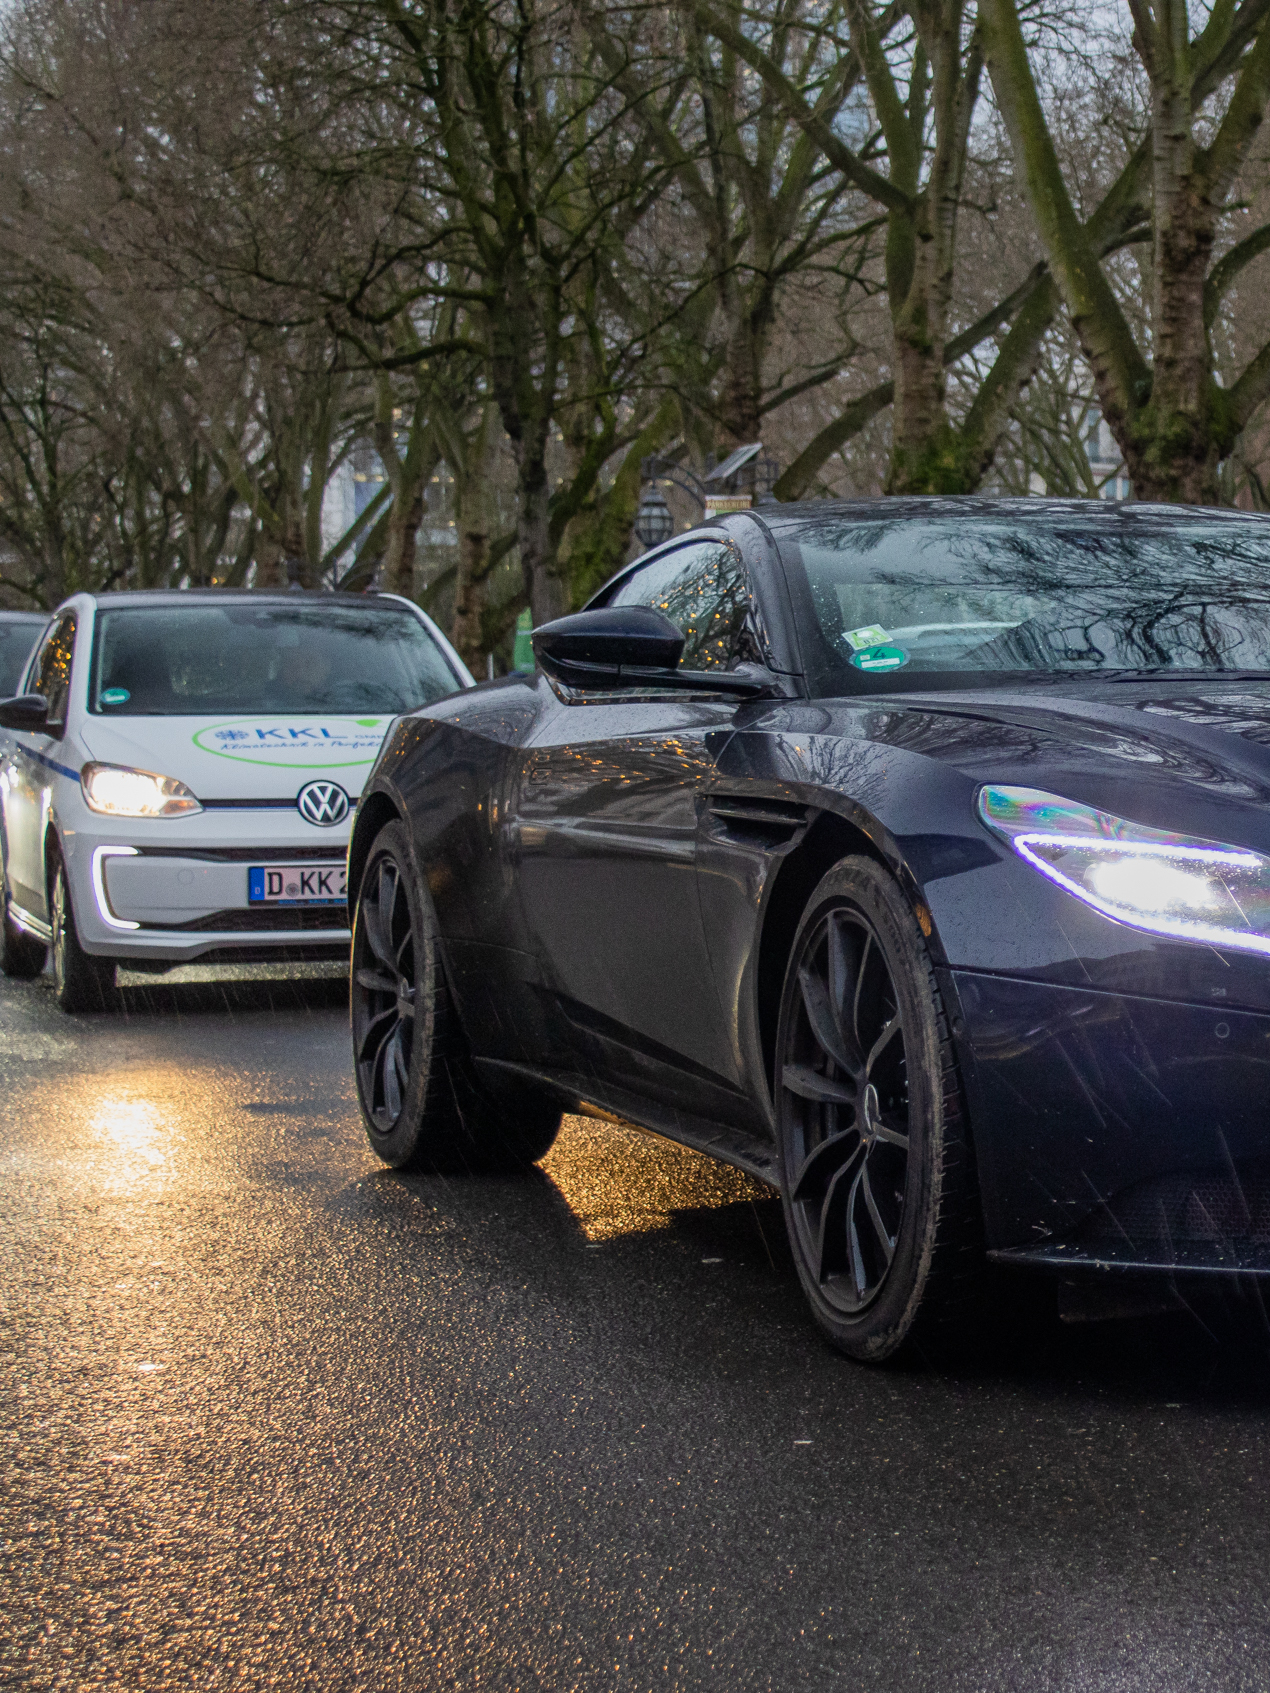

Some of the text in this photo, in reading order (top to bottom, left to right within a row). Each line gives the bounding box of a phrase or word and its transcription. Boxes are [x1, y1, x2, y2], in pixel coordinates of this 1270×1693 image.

[873, 648, 886, 659] 4
[255, 728, 348, 739] KKL
[267, 872, 283, 896] D
